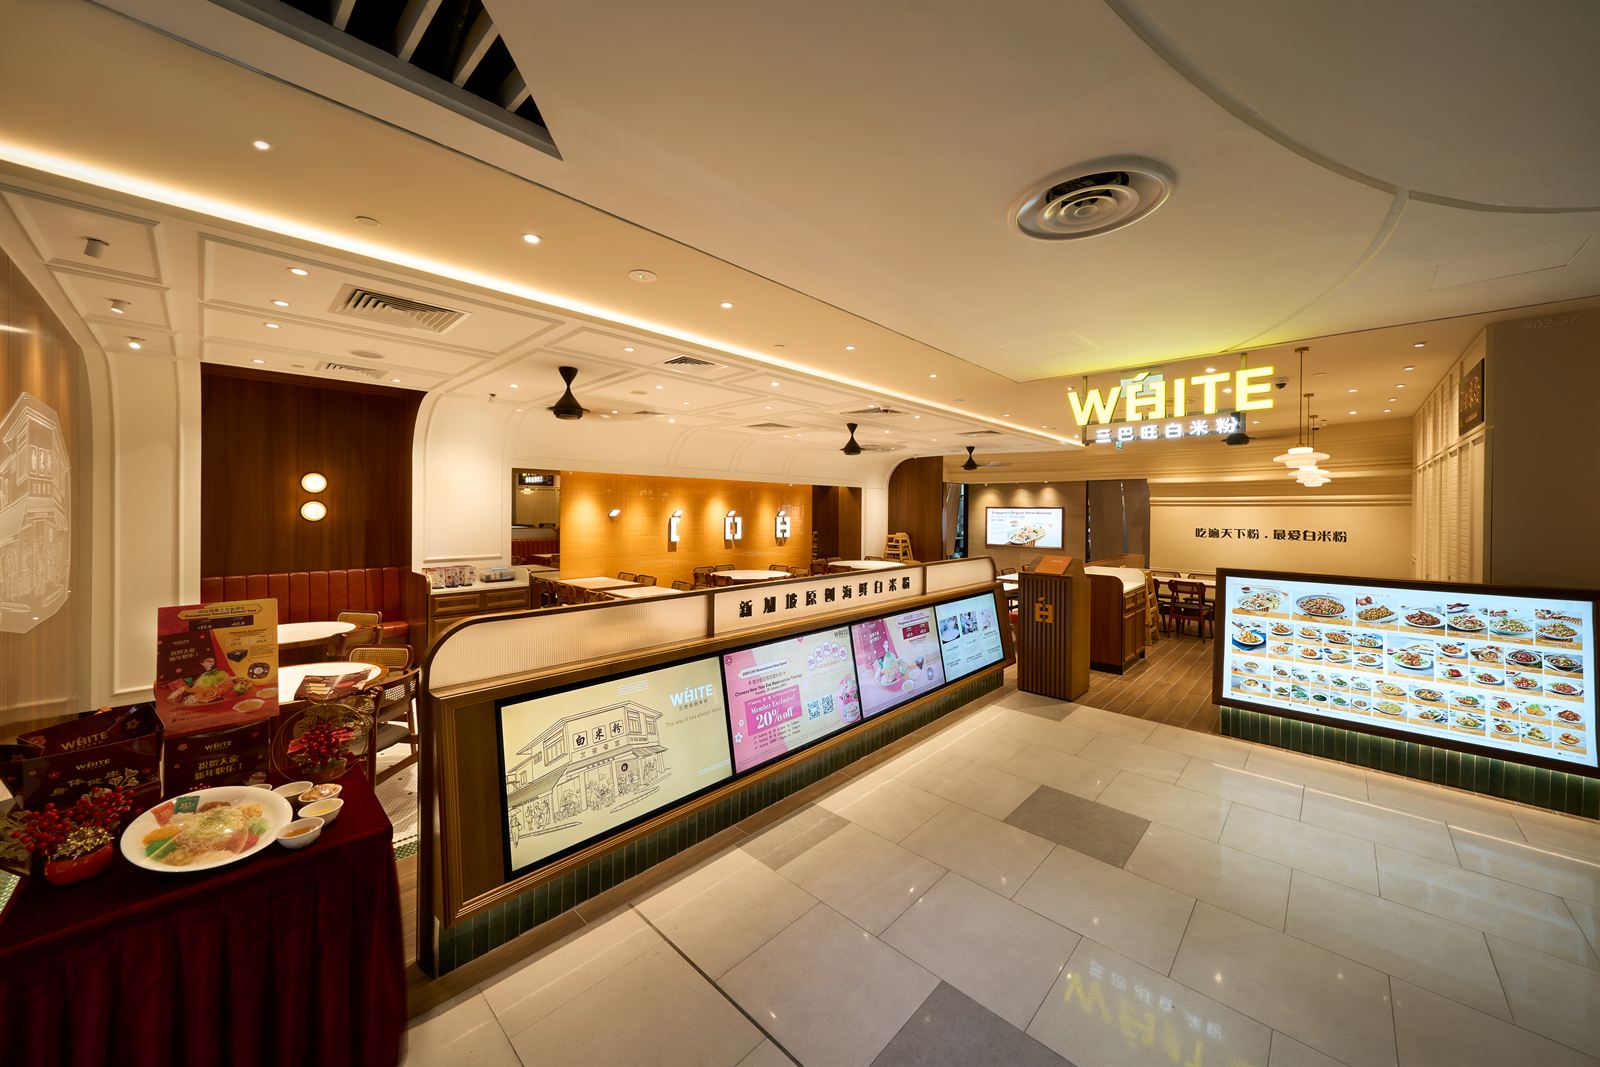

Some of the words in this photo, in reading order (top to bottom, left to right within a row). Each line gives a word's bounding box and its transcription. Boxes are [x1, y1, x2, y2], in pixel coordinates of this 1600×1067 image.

[1068, 366, 1274, 426] WHITE
[1096, 416, 1239, 443] 三巴旺白米粉
[756, 708, 782, 729] 20%
[783, 706, 794, 719] off
